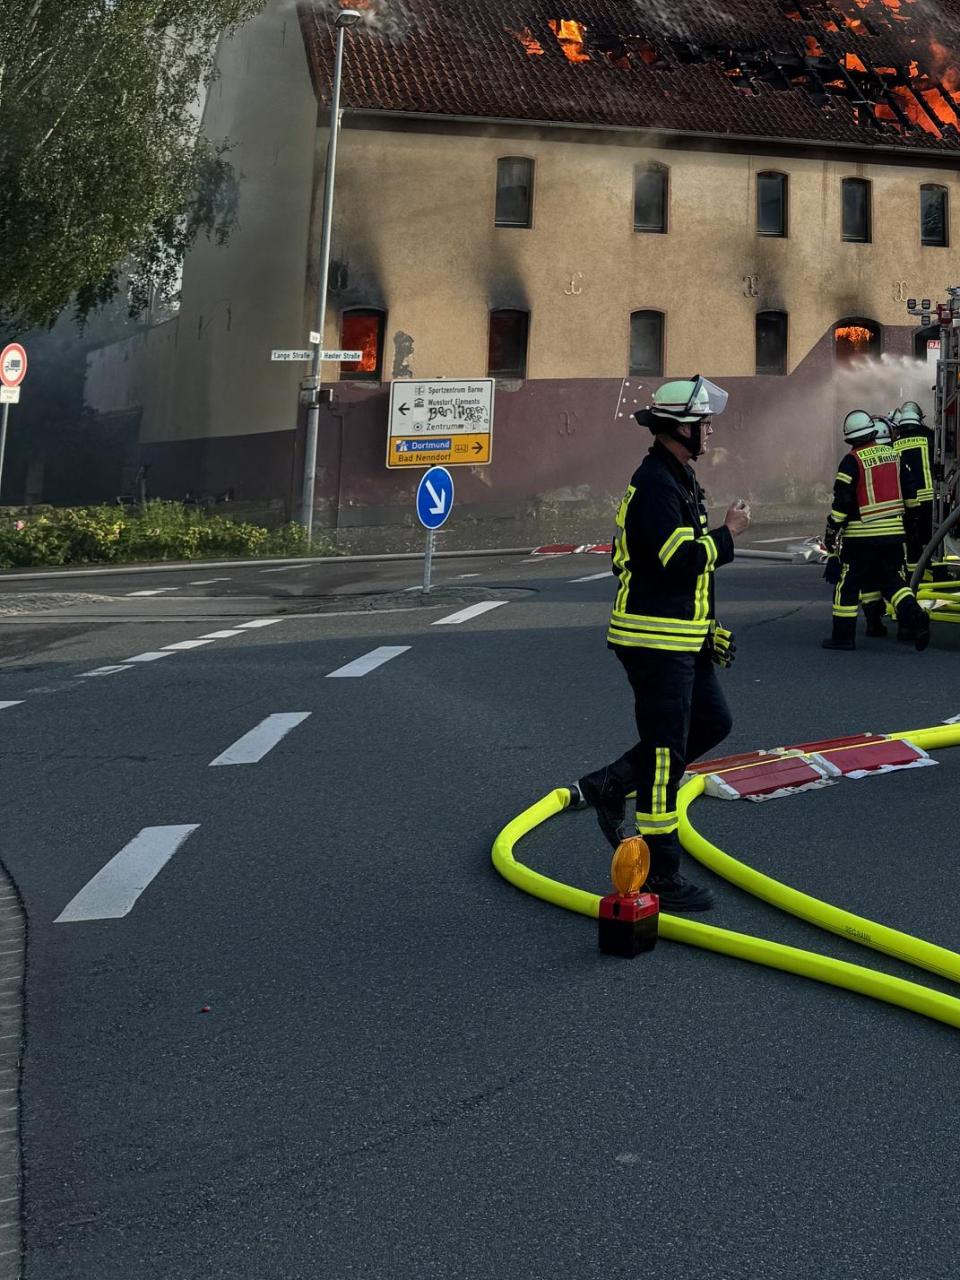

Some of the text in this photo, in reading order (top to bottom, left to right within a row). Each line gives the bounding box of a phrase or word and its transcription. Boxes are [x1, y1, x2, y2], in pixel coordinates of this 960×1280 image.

[292, 351, 310, 359] Straße
[428, 387, 466, 395] Sportzentrum
[411, 439, 450, 450] Dortmund
[398, 453, 451, 462] Bad Nenndorf
